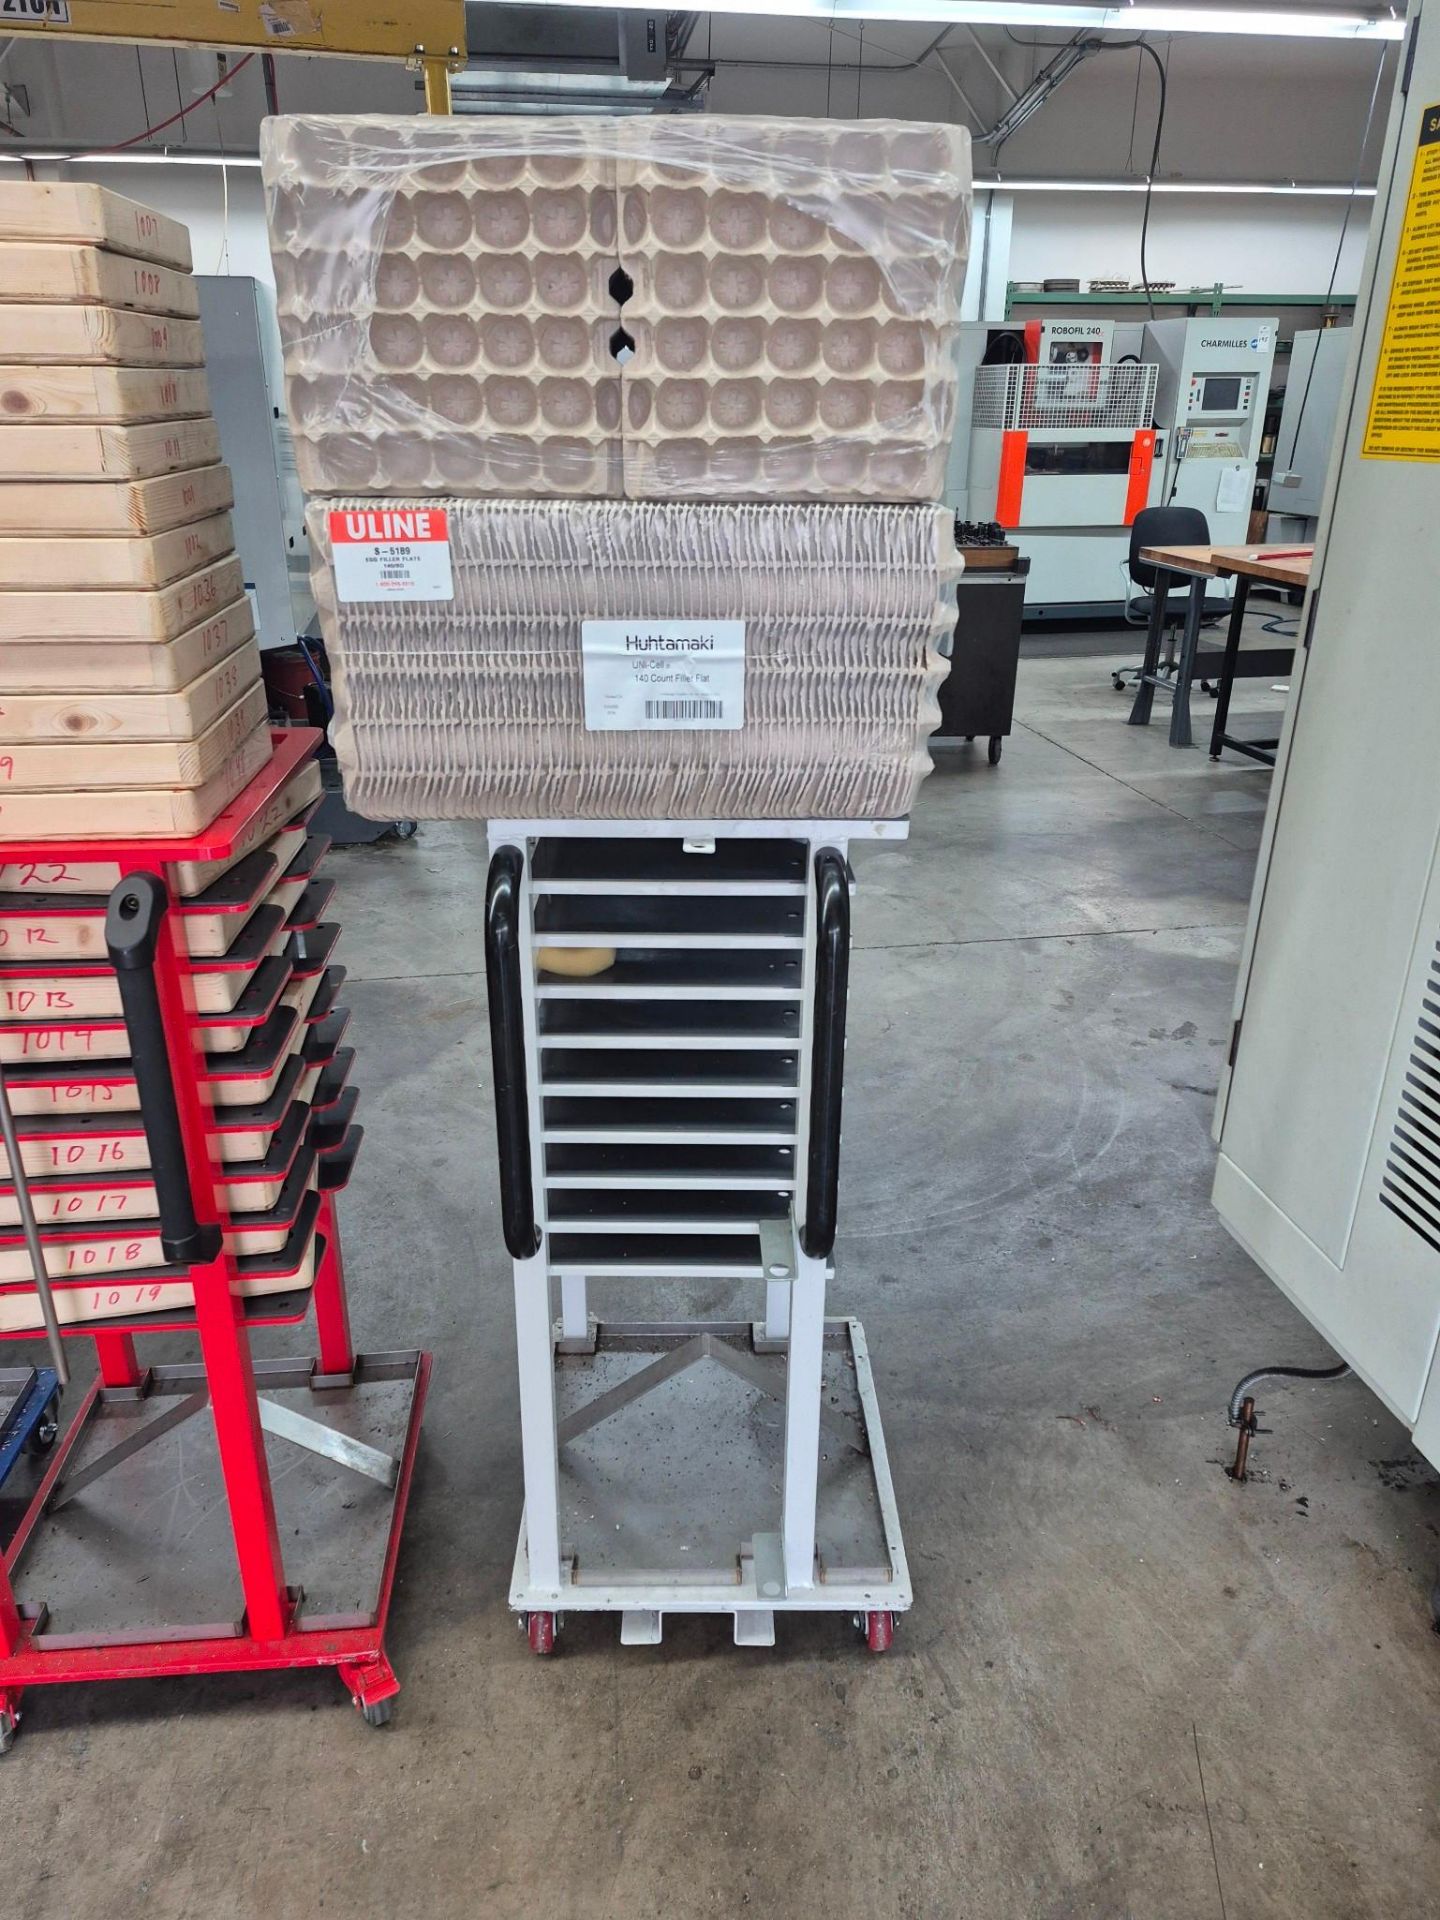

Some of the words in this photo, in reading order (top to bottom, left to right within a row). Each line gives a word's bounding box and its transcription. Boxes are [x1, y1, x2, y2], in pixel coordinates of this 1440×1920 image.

[1051, 326, 1085, 336] ROBOFIL
[1086, 326, 1101, 336] 240
[1200, 339, 1248, 349] CHARMILLES
[345, 513, 431, 540] ULINE
[626, 635, 714, 651] Huhtamaki
[635, 674, 649, 683] 140
[650, 674, 674, 683] Count
